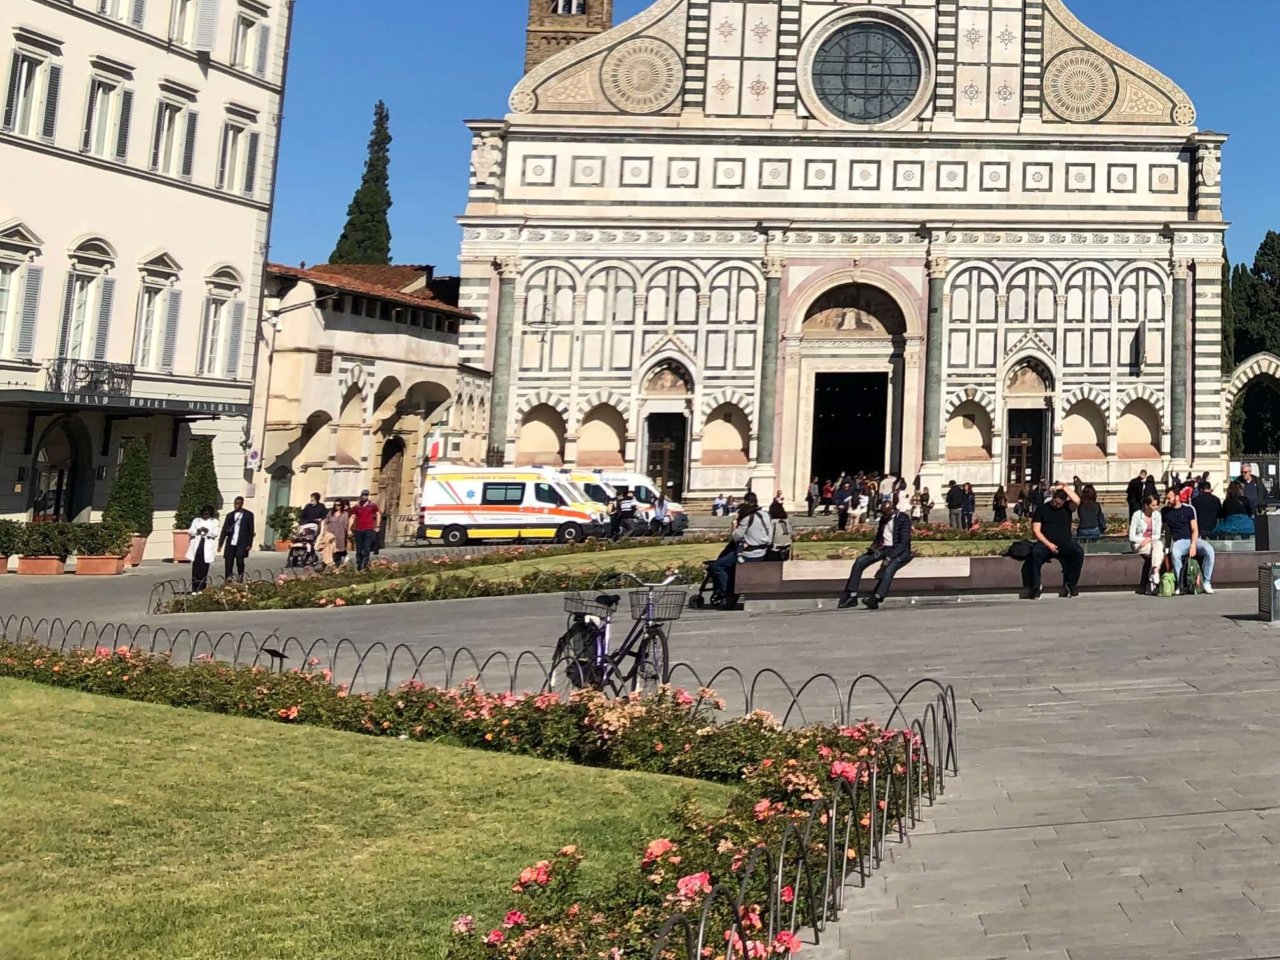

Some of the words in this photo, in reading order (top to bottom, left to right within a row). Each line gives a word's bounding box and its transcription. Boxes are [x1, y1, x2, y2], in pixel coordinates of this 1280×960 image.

[64, 394, 109, 405] GRAND
[130, 398, 168, 409] HOTEL
[187, 401, 236, 413] MINERVA
